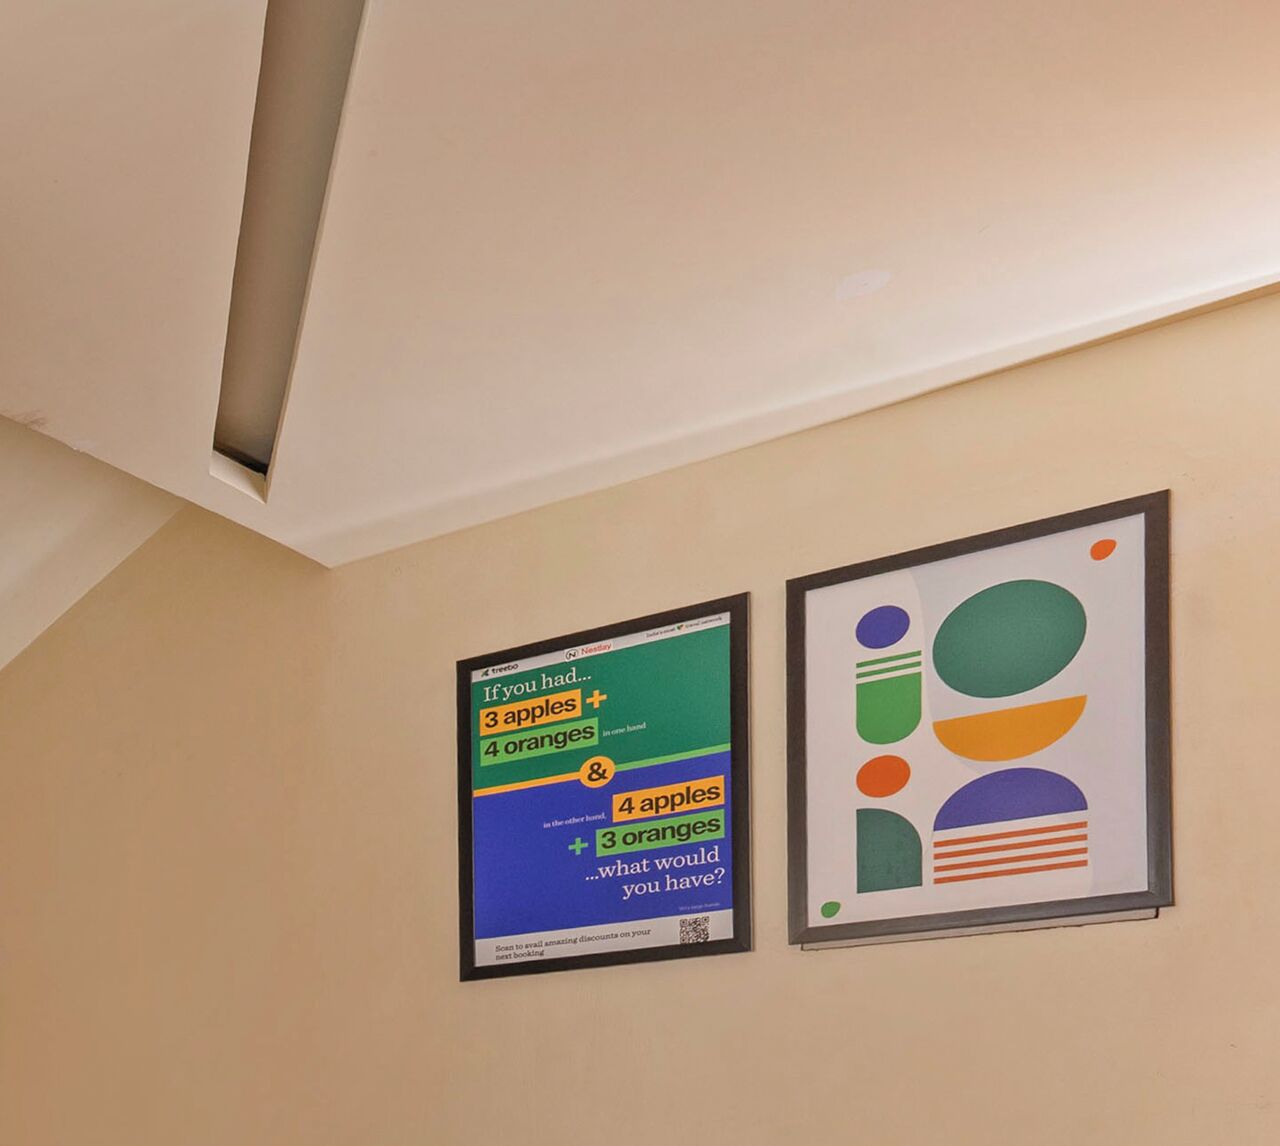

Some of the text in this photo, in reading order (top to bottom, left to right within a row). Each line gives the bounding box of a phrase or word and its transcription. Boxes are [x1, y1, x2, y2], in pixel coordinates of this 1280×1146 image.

[491, 663, 519, 674] treebo
[483, 666, 592, 703] If you had...
[484, 711, 498, 728] 3
[503, 698, 577, 725] apples
[484, 725, 595, 757] 4 oranges
[587, 762, 609, 783] &
[618, 785, 721, 815] 4 apples
[601, 831, 617, 849] 3
[622, 818, 721, 846] oranges
[654, 845, 721, 870] would
[622, 866, 726, 900] you have?
[495, 945, 515, 953] Scan
[515, 943, 524, 951] to
[524, 940, 543, 949] avail
[544, 937, 578, 947] amazing
[579, 933, 619, 942] discounts
[631, 929, 652, 938] your
[495, 949, 545, 961] next booking
